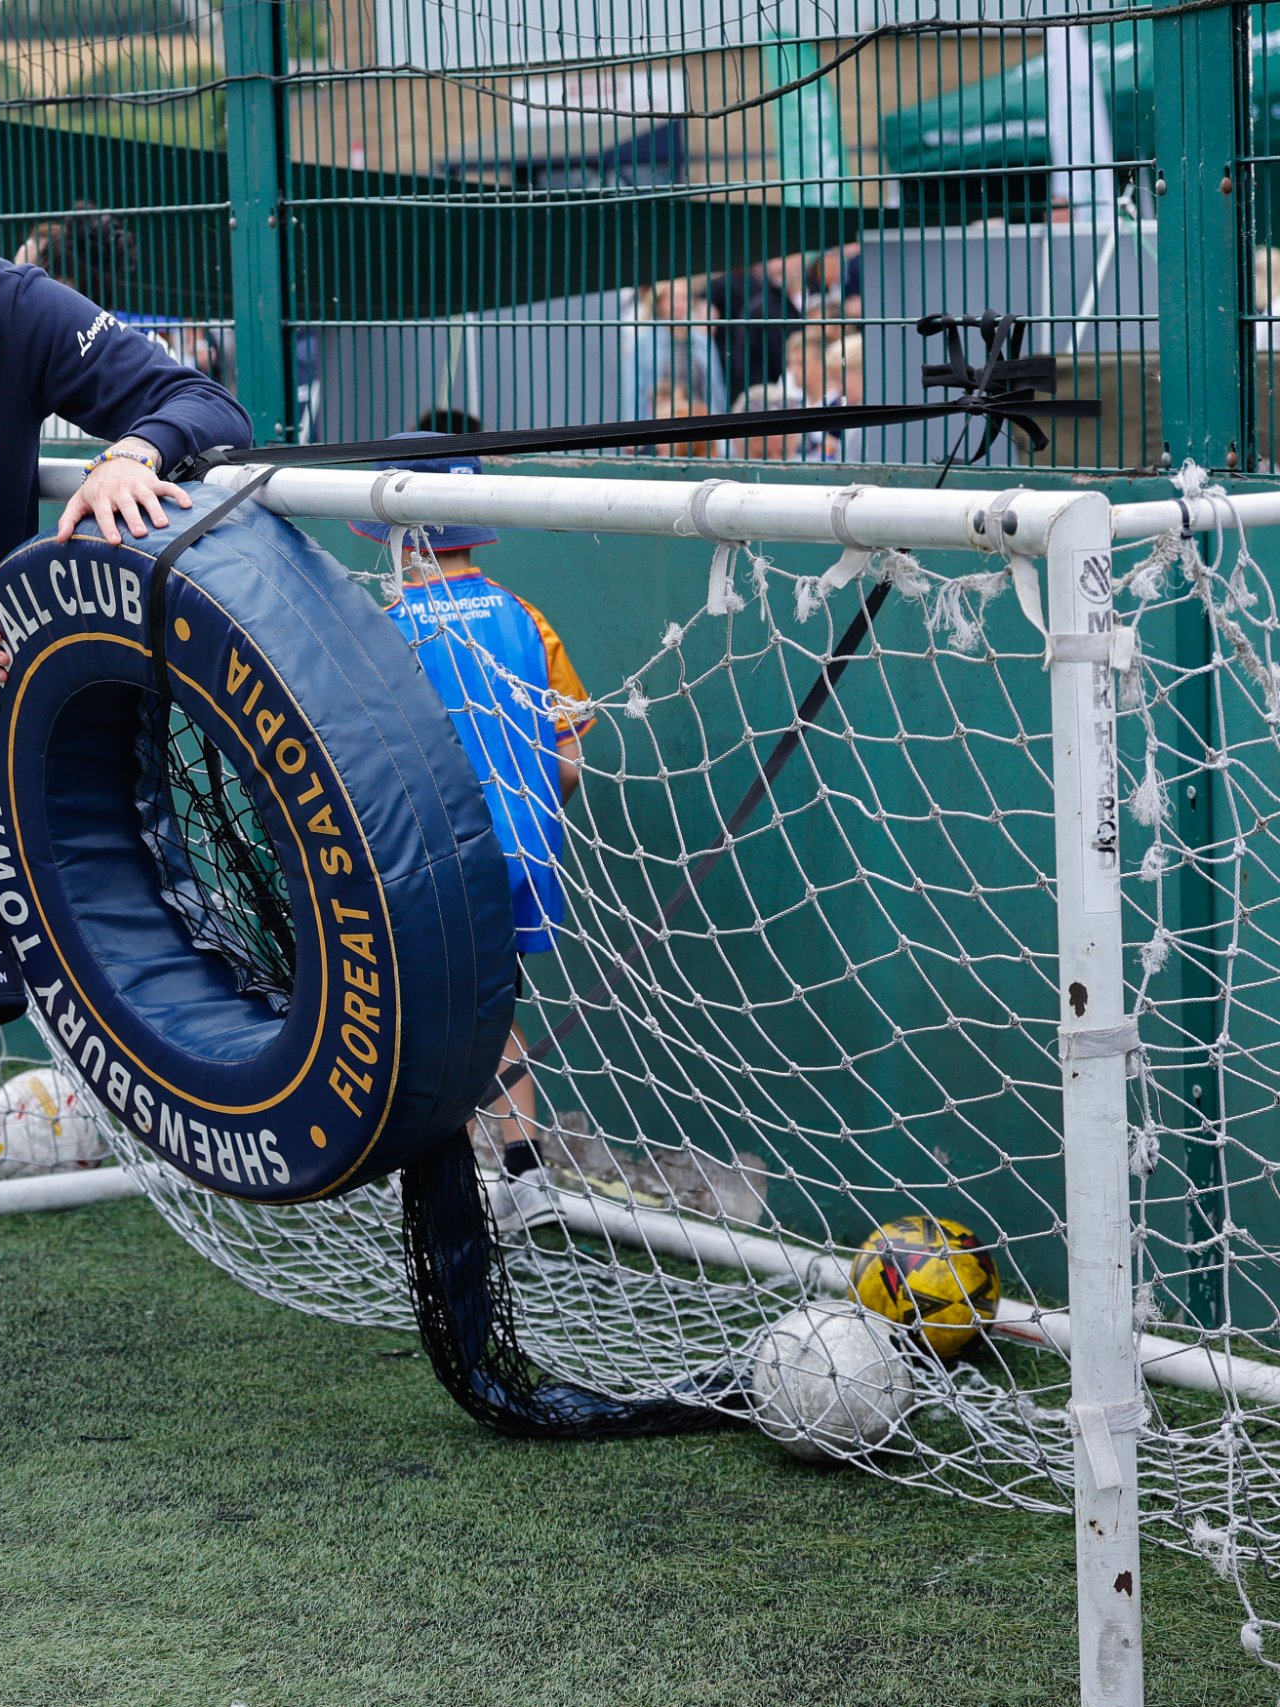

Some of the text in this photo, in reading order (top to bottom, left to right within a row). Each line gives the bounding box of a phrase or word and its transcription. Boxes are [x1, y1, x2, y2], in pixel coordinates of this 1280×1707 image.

[49, 559, 142, 625] CLUB
[1087, 610, 1113, 711] MRK
[225, 646, 380, 1118] FLOREAT SALOPIA
[35, 978, 291, 1185] SHREWSBURY
